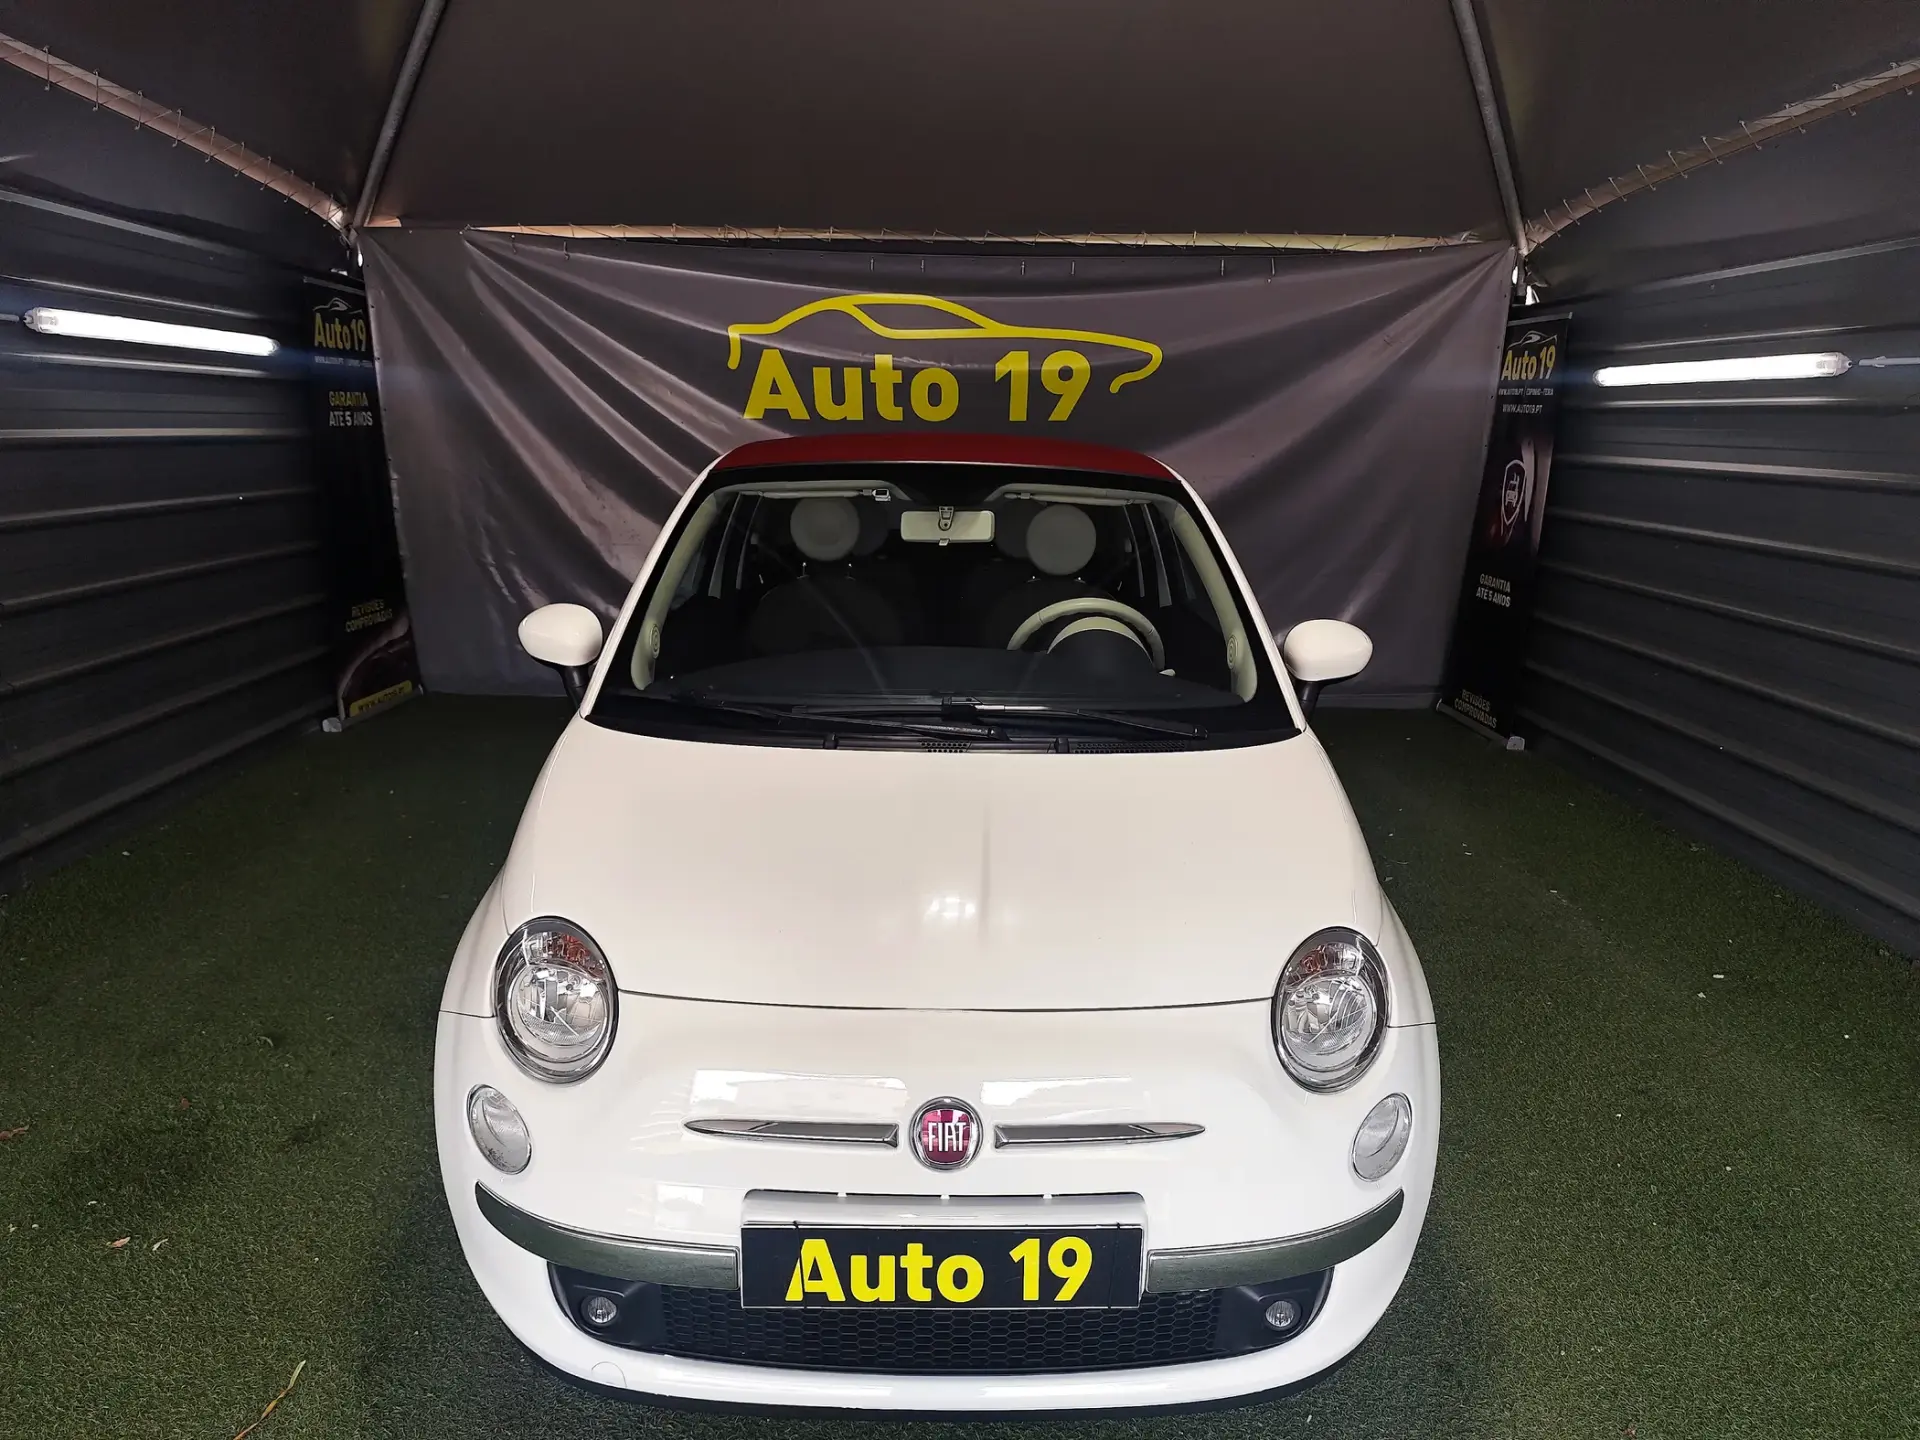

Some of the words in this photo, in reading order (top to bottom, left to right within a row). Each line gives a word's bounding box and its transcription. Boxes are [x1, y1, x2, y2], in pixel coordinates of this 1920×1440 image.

[314, 312, 351, 350] Auto
[352, 318, 367, 352] 19
[1500, 349, 1538, 381] Auto
[1539, 345, 1556, 380] 19
[328, 391, 369, 407] GARANTIA
[742, 348, 960, 422] Auto
[994, 349, 1091, 422] 19
[345, 411, 352, 427] 5
[1479, 573, 1511, 593] GARANTIA
[1492, 592, 1512, 608] ANOS
[927, 1121, 968, 1153] FIAT
[785, 1238, 985, 1304] Auto
[1008, 1236, 1094, 1303] 19
